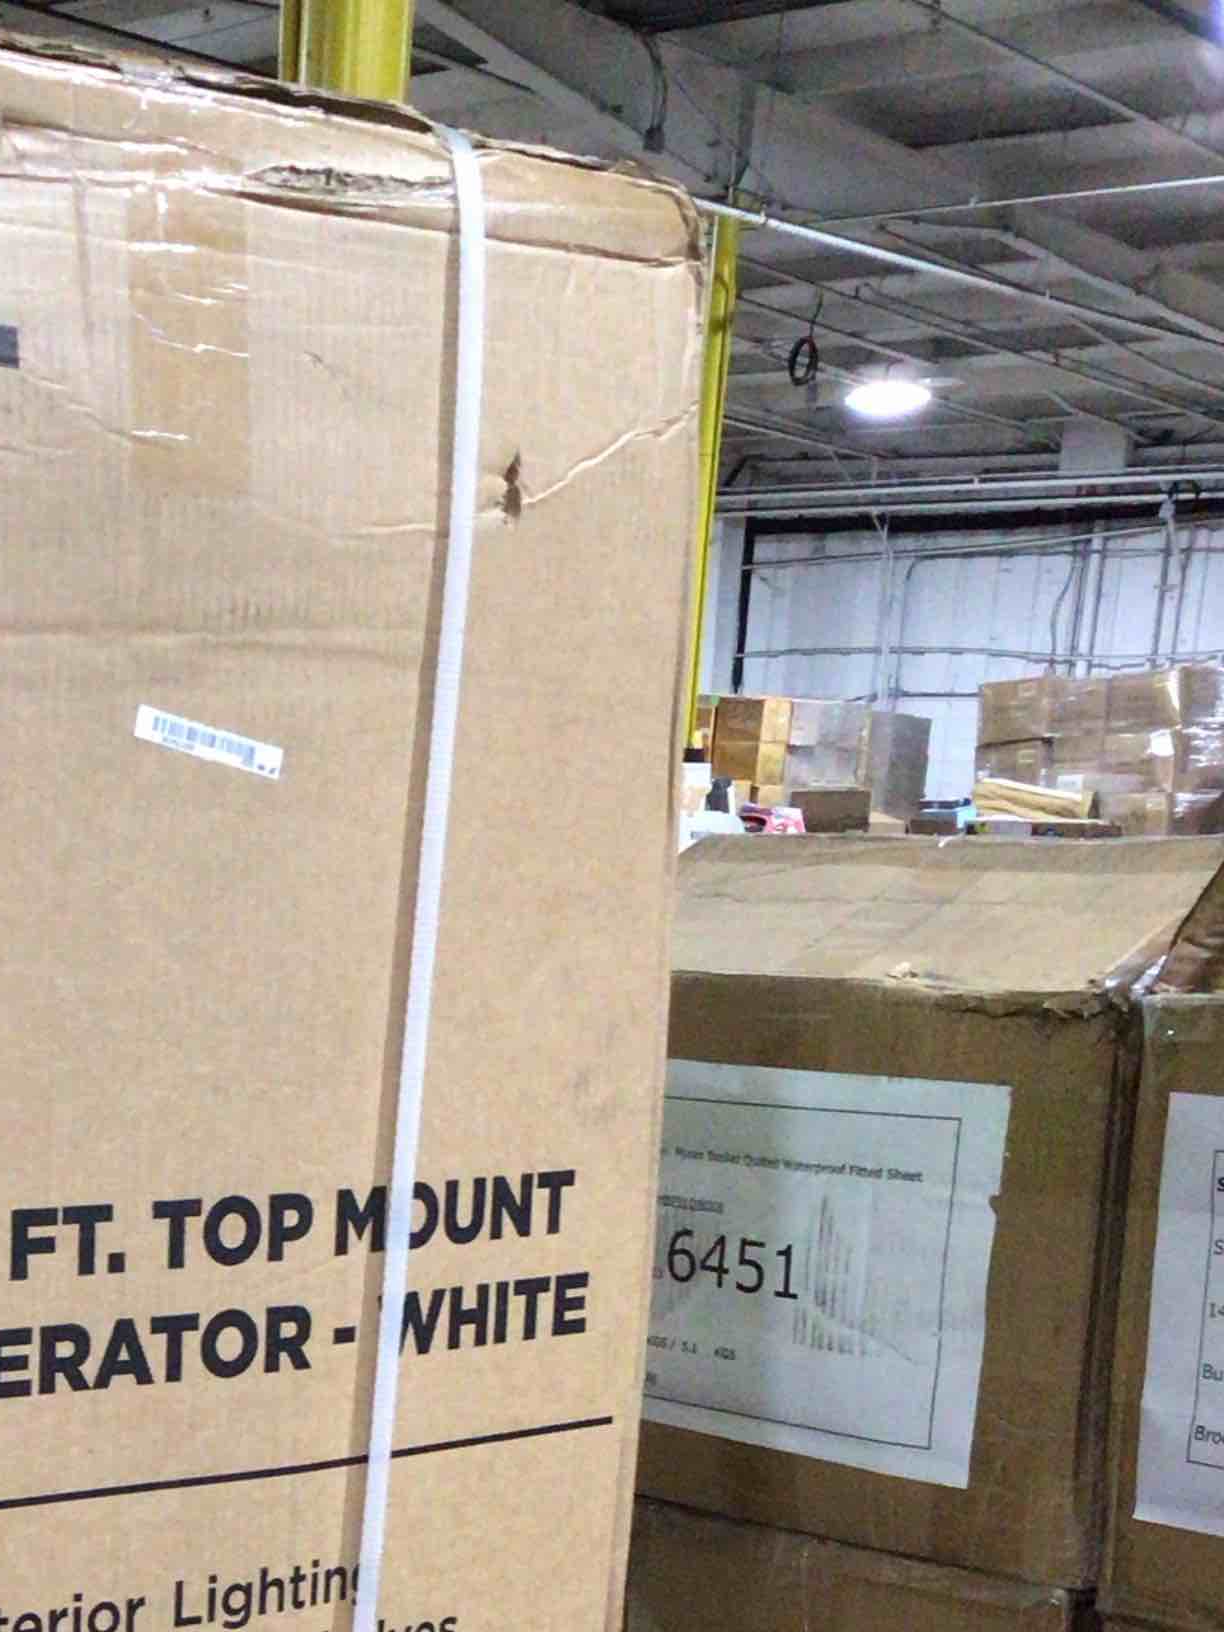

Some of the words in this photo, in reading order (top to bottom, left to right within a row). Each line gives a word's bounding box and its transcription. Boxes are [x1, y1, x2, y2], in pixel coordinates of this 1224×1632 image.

[9, 1203, 126, 1281] FT.
[153, 1193, 314, 1270] TOP
[667, 1228, 799, 1300] 6451
[332, 1325, 356, 1345] -
